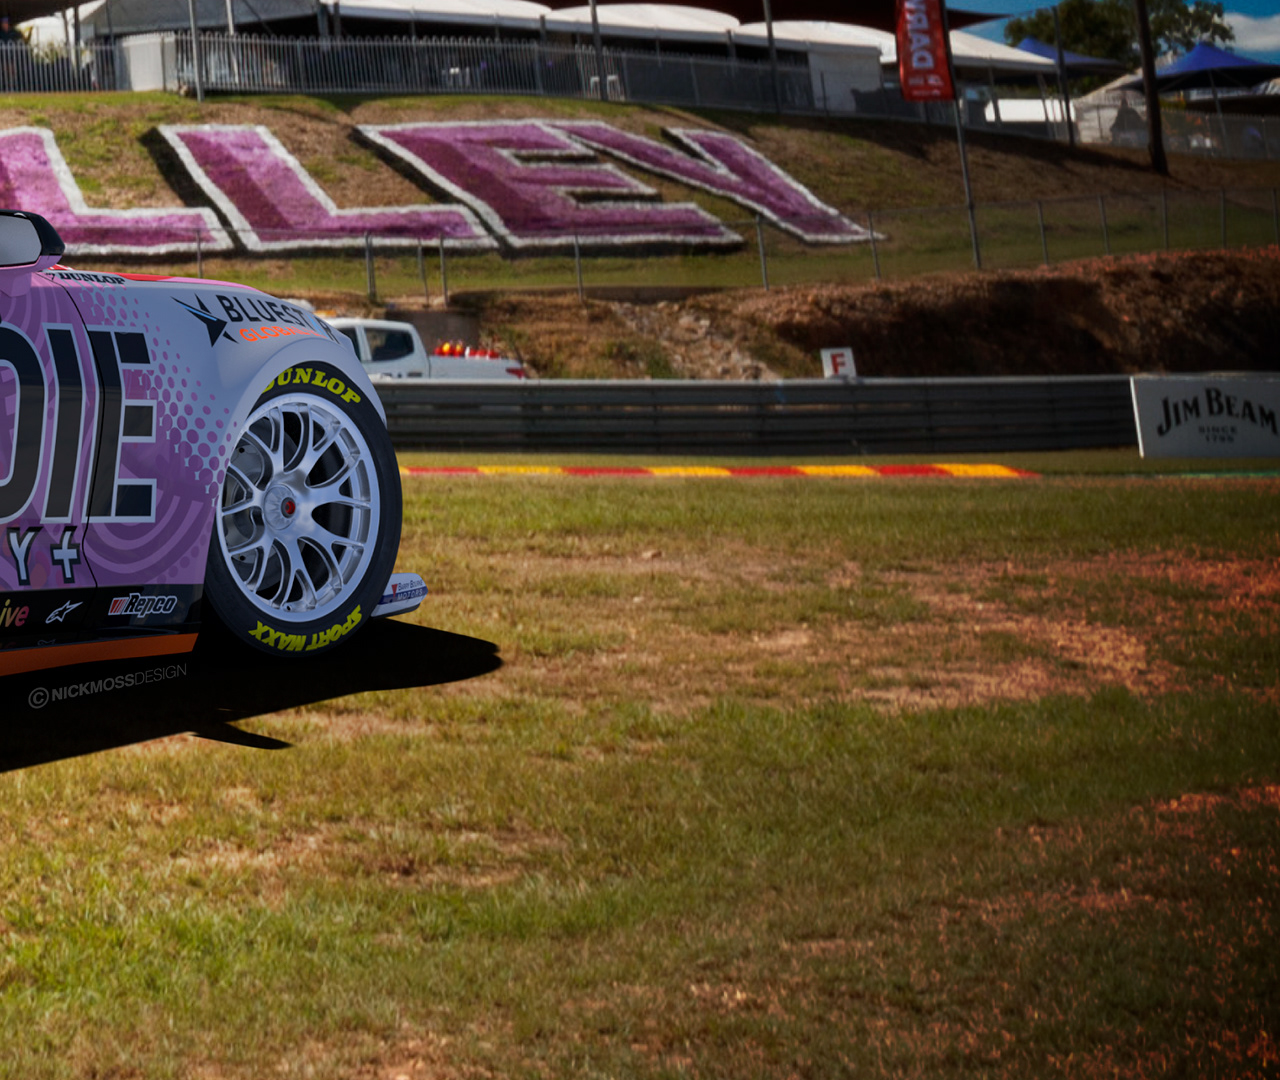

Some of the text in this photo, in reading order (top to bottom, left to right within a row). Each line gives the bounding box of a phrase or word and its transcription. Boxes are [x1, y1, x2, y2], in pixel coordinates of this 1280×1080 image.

[58, 272, 126, 284] DUNLOP
[1157, 387, 1280, 437] JIM BEAM
[125, 593, 178, 618] Repco
[248, 604, 362, 652] SPORT MAXX
